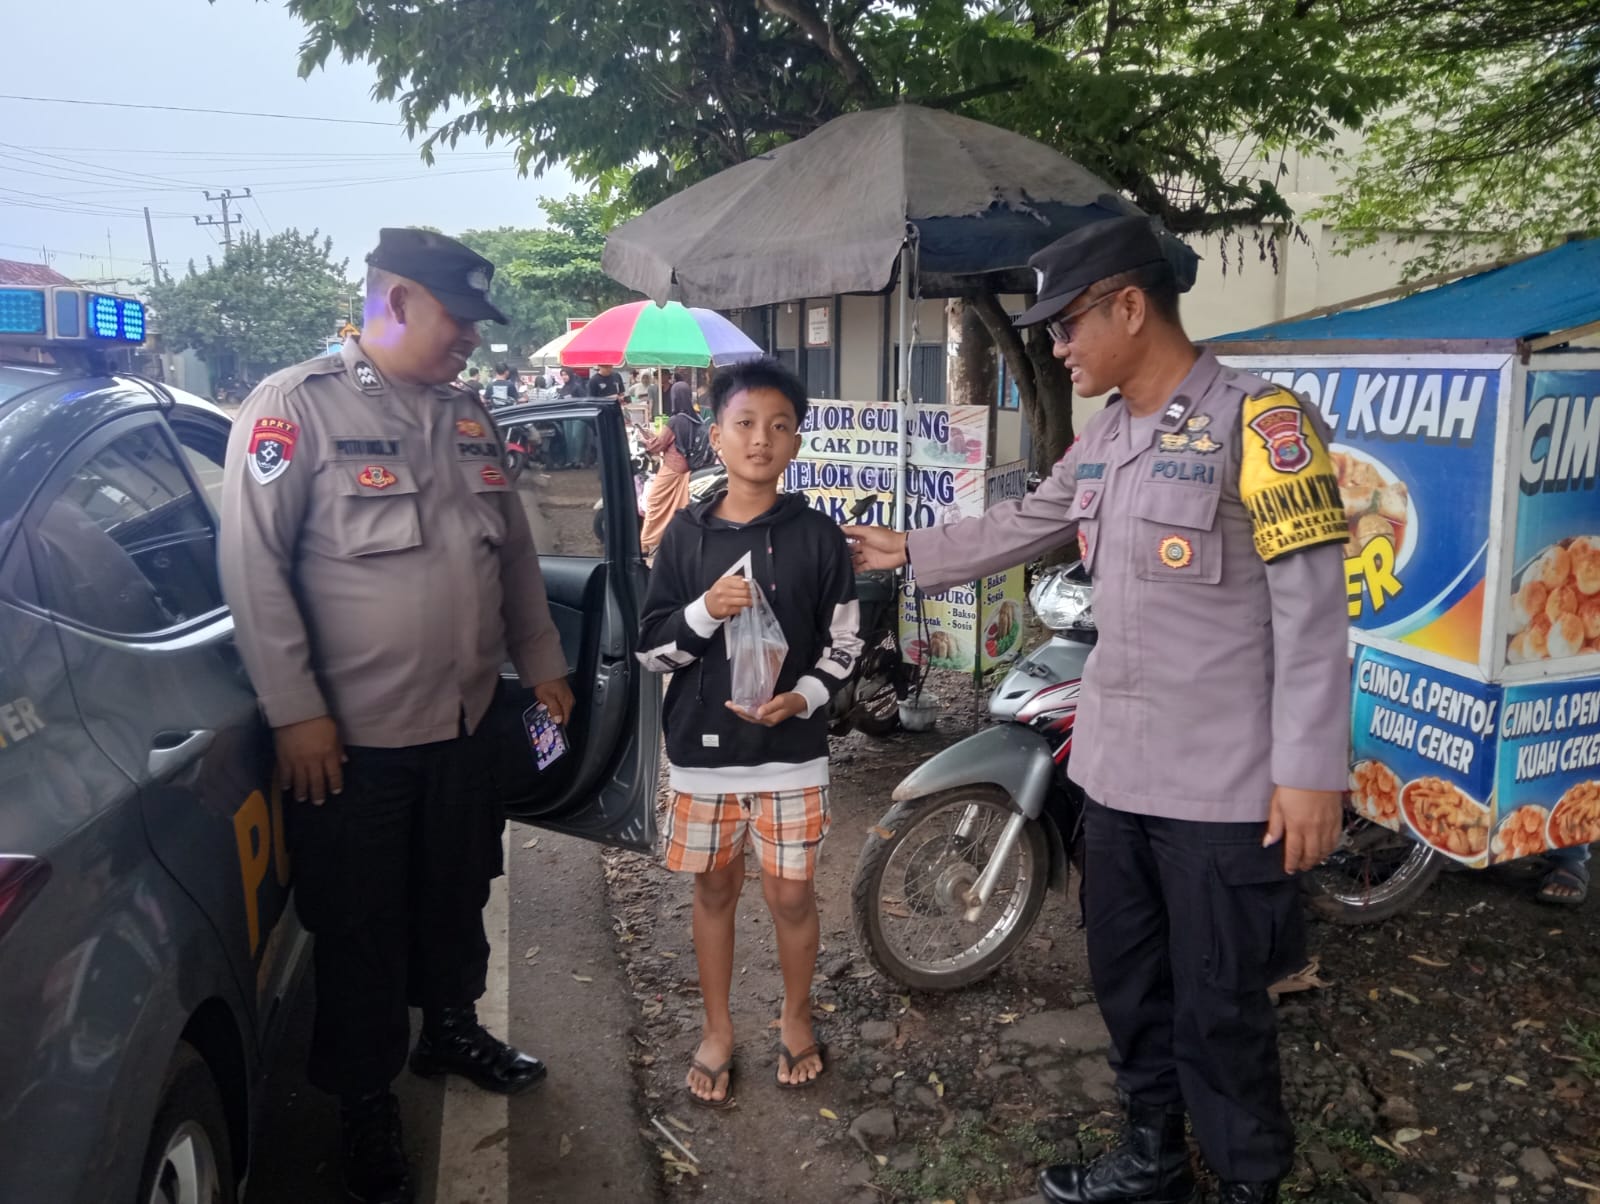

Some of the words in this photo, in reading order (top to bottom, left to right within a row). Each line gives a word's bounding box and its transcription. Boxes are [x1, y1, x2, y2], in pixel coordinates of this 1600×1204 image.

[1348, 373, 1487, 442] KUAH
[810, 436, 851, 454] CAK
[1520, 396, 1600, 492] CIM
[860, 466, 955, 504] GUUNG
[1152, 461, 1215, 484] POLRI
[805, 495, 847, 526] AK
[952, 607, 976, 620] Bakso
[952, 620, 973, 631] Sosis
[1359, 660, 1410, 705] CIMOL
[1412, 677, 1427, 712] &
[1425, 681, 1497, 736] PENTOL
[1502, 697, 1553, 740] CIMOL
[1555, 694, 1568, 731] &
[1370, 705, 1418, 750] KUAH
[1417, 724, 1475, 775] CEKER
[1515, 740, 1561, 782] KUAH
